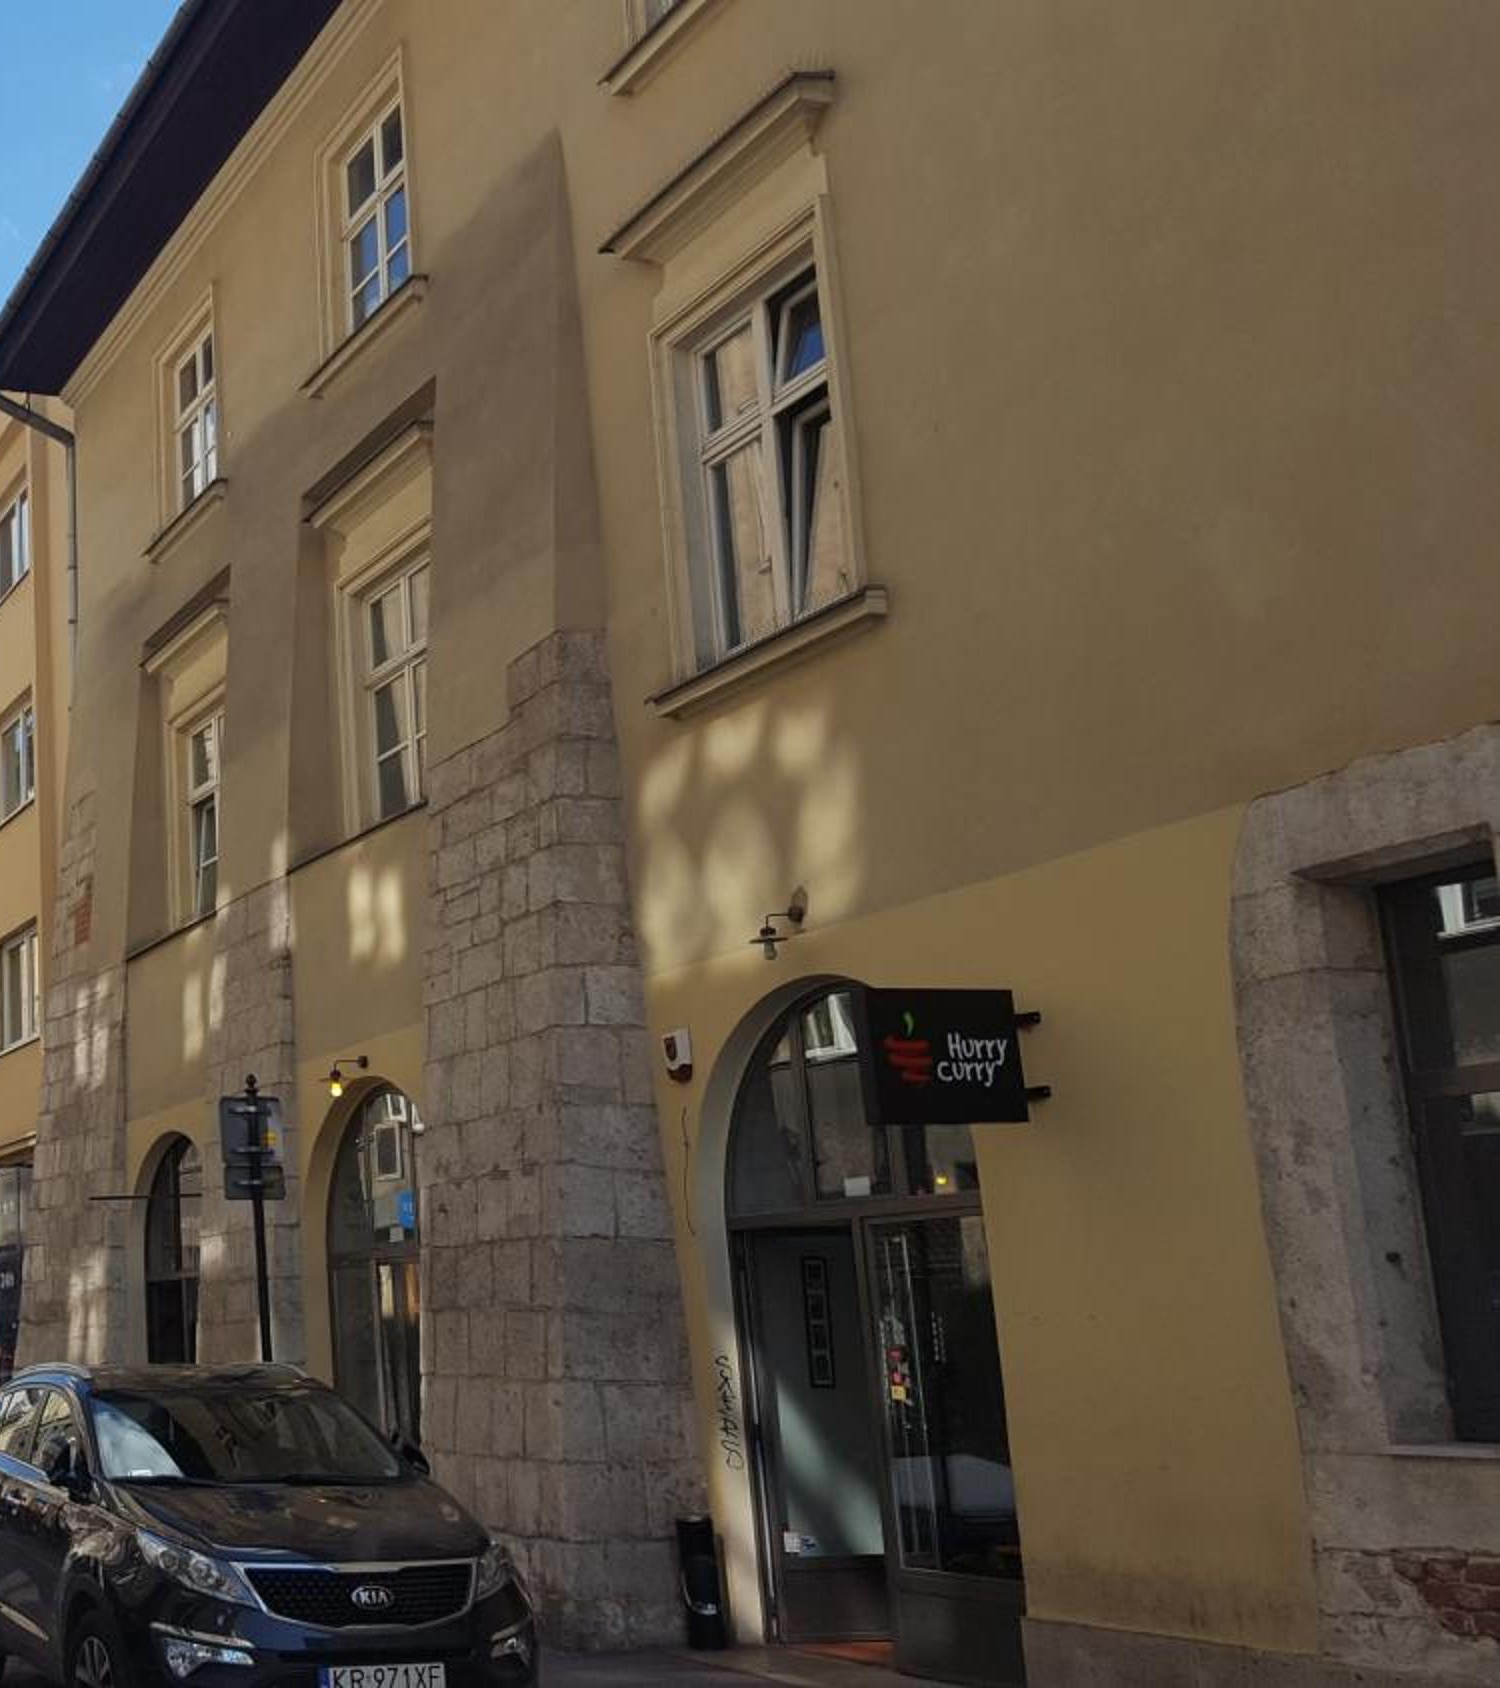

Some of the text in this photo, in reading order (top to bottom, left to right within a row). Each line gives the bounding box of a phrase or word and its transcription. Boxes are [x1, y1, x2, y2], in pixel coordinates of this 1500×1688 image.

[947, 1032, 1008, 1065] Hurry
[358, 1589, 390, 1606] KIA
[333, 1668, 365, 1688] KR
